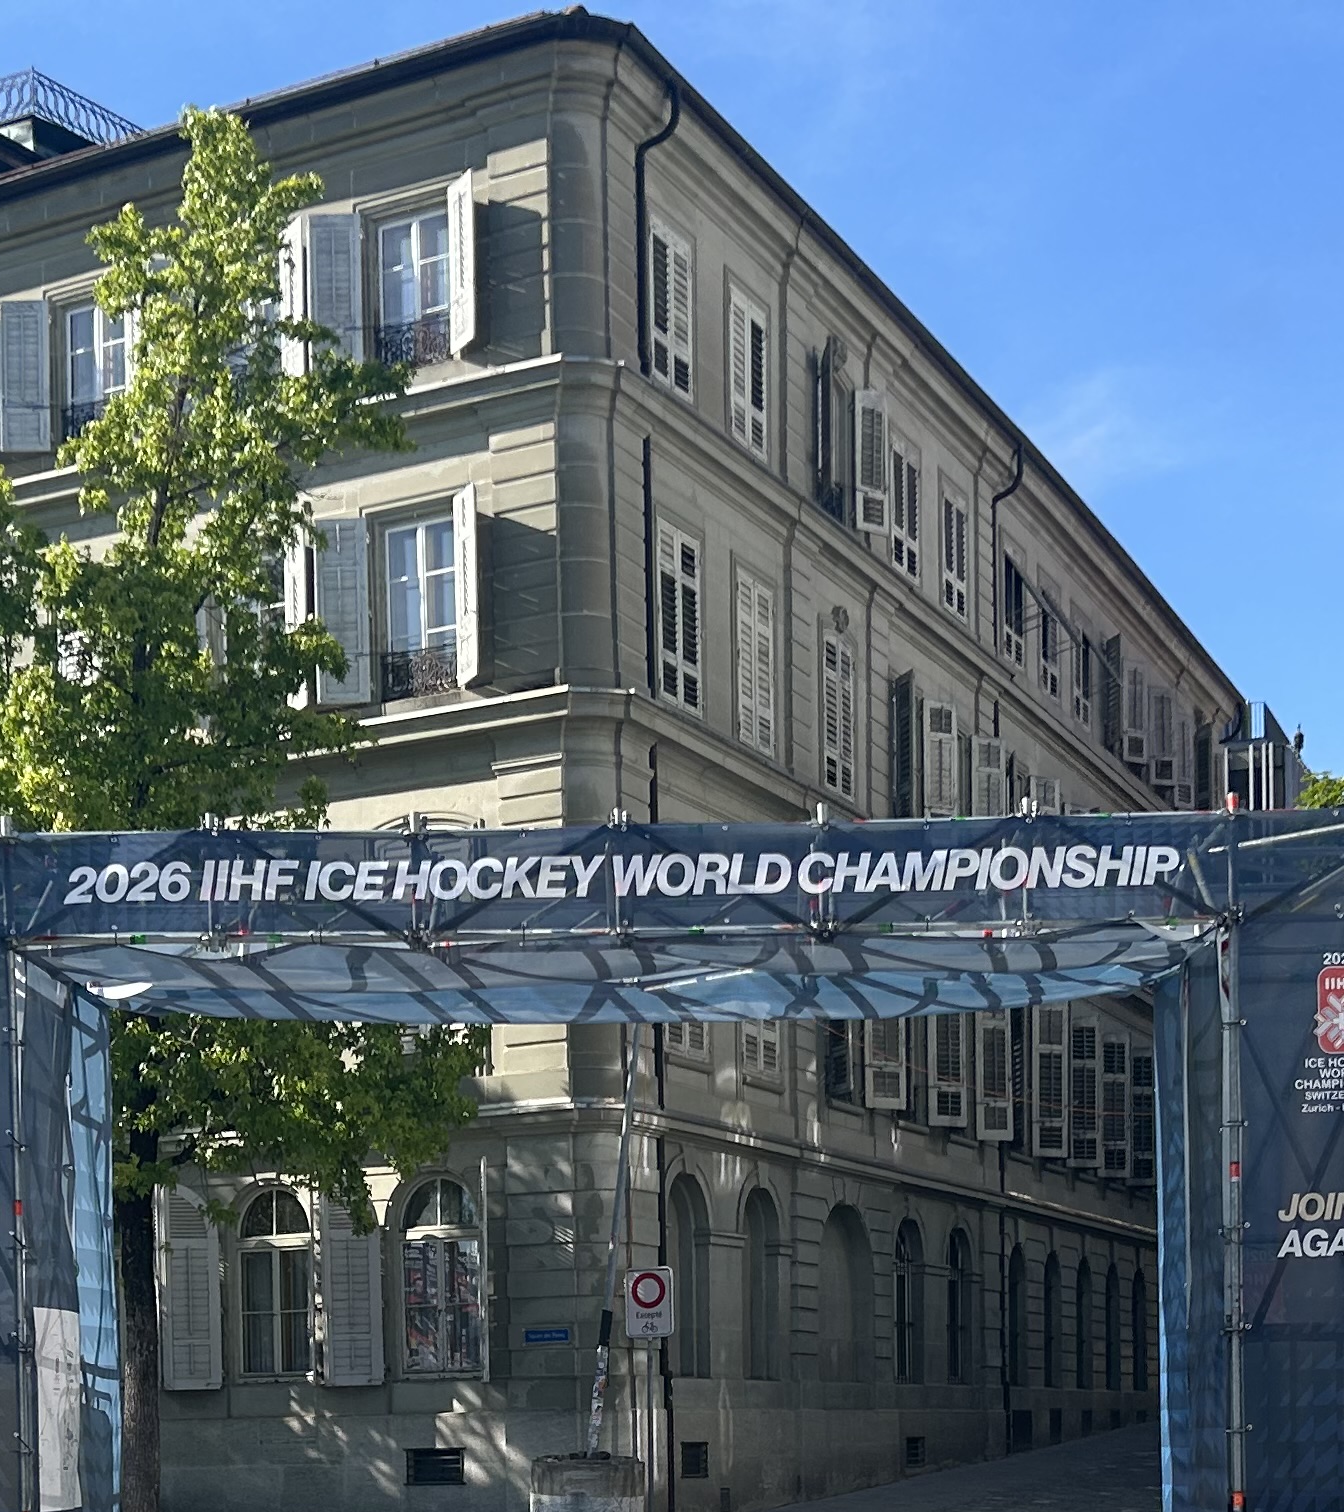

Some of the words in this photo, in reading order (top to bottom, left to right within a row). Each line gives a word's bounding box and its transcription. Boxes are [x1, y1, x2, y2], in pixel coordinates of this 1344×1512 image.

[63, 861, 191, 904] 2026
[199, 858, 306, 902] IIHF
[304, 860, 390, 901] ICE
[392, 855, 607, 900] HOCKEY
[613, 852, 792, 897] WORLD
[797, 845, 1181, 894] CHAMPIONSHIP
[1304, 1057, 1325, 1069] ICE
[1301, 1103, 1334, 1113] Zurich
